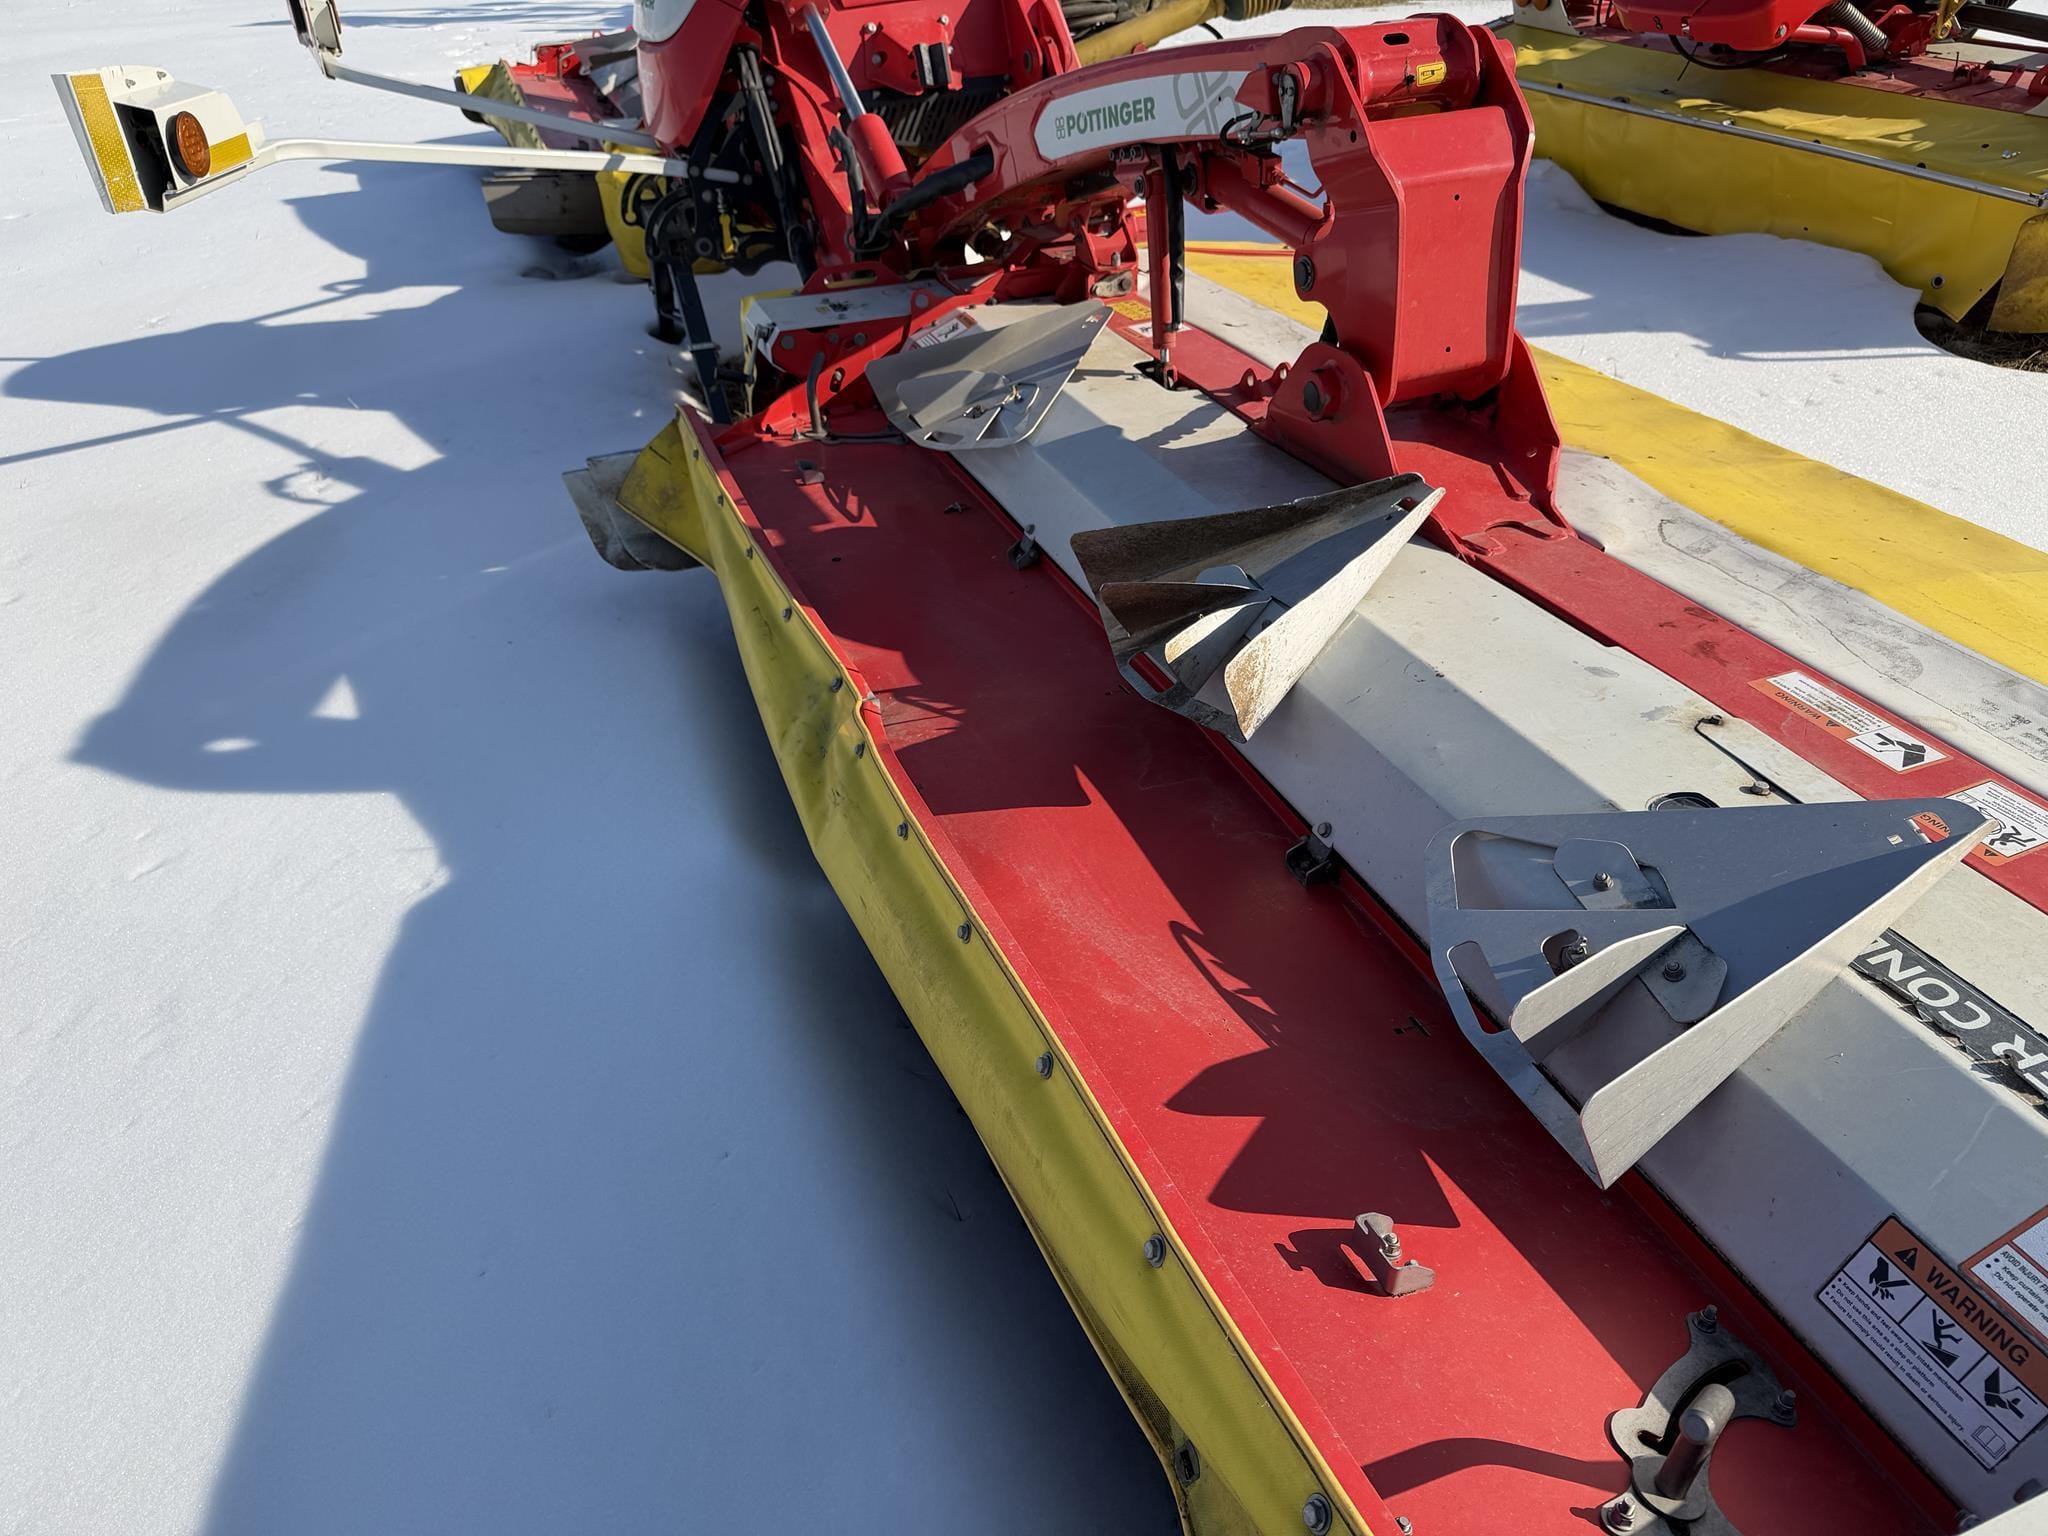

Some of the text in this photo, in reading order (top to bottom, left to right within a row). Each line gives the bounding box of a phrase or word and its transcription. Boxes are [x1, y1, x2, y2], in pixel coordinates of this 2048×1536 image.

[1775, 692, 1821, 719] WARNING
[1994, 1271, 2004, 1281] Do
[2004, 1280, 2016, 1291] not
[2015, 1290, 2039, 1313] operate
[2000, 1251, 2020, 1267] AVOID
[2020, 1265, 2042, 1286] INJURY
[2002, 1266, 2045, 1305] Keep curtains
[1836, 1289, 1844, 1298] Do
[1843, 1297, 1853, 1306] not
[1852, 1305, 1862, 1315] use
[1862, 1314, 1872, 1325] this
[1872, 1324, 1883, 1336] area
[1894, 1347, 1906, 1359] step
[1912, 1365, 1935, 1388] platform
[1842, 1282, 1964, 1402] Keep hands and feet away from intake mechanism
[1926, 1265, 2030, 1367] WARNING
[1830, 1295, 1847, 1313] Failure
[1852, 1319, 1871, 1337] comply
[1870, 1336, 1885, 1352] could
[1884, 1351, 1900, 1366] result
[1905, 1372, 1920, 1388] death
[1927, 1394, 1948, 1415] serious
